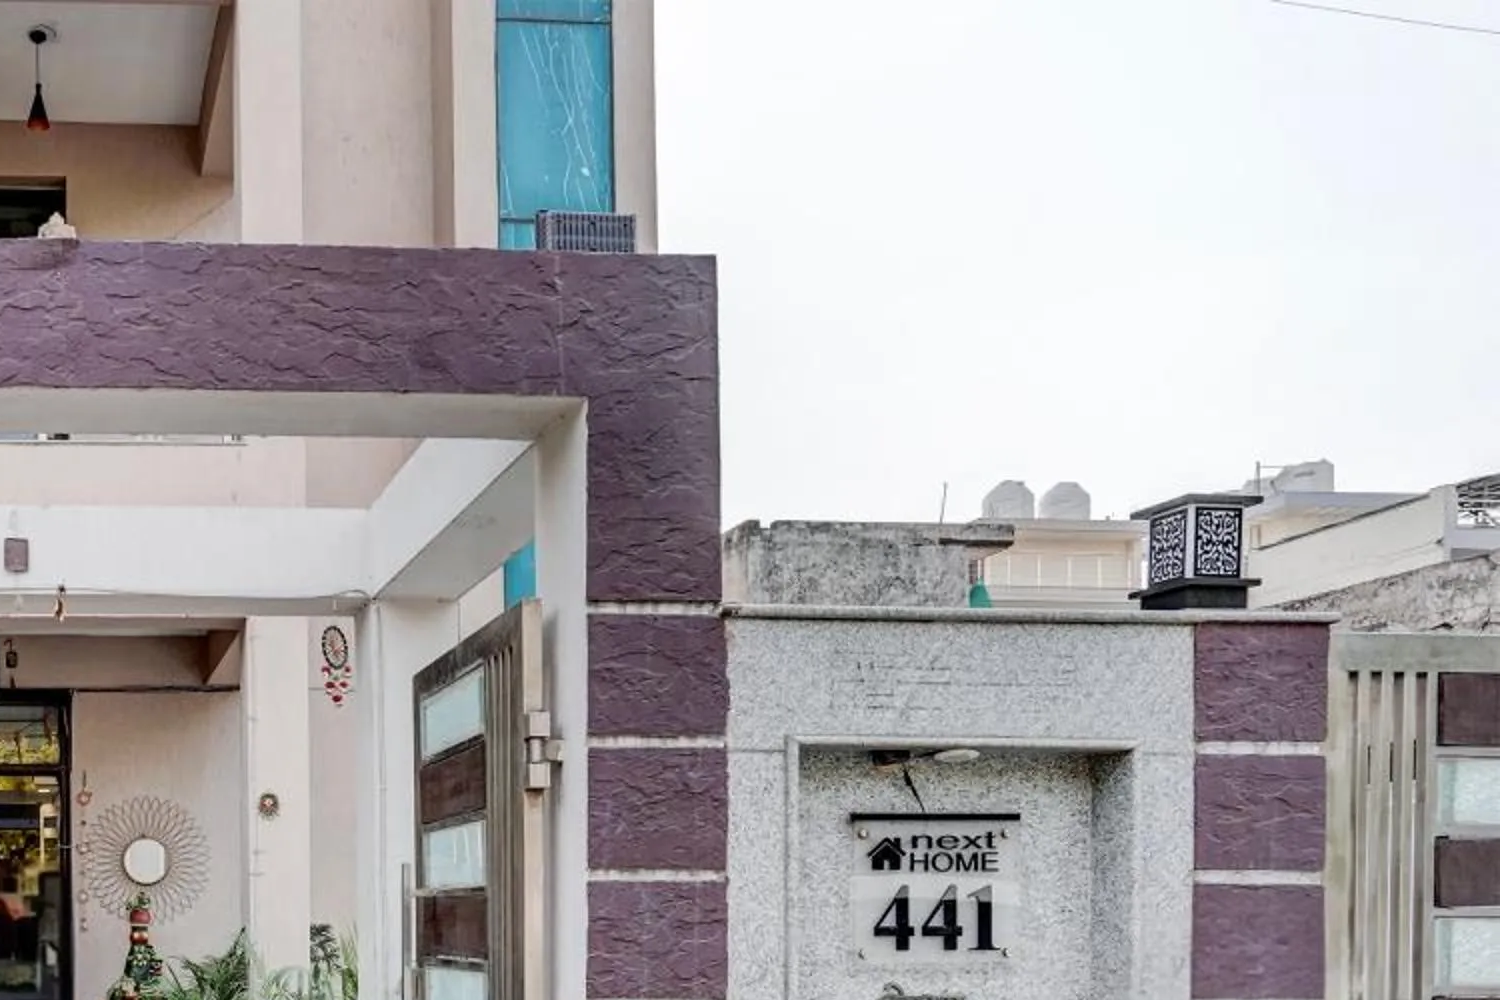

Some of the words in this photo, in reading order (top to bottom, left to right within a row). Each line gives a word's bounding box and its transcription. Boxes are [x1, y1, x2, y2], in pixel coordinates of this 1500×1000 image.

[911, 832, 996, 849] next
[909, 851, 999, 872] HOME
[873, 883, 1000, 951] 441
